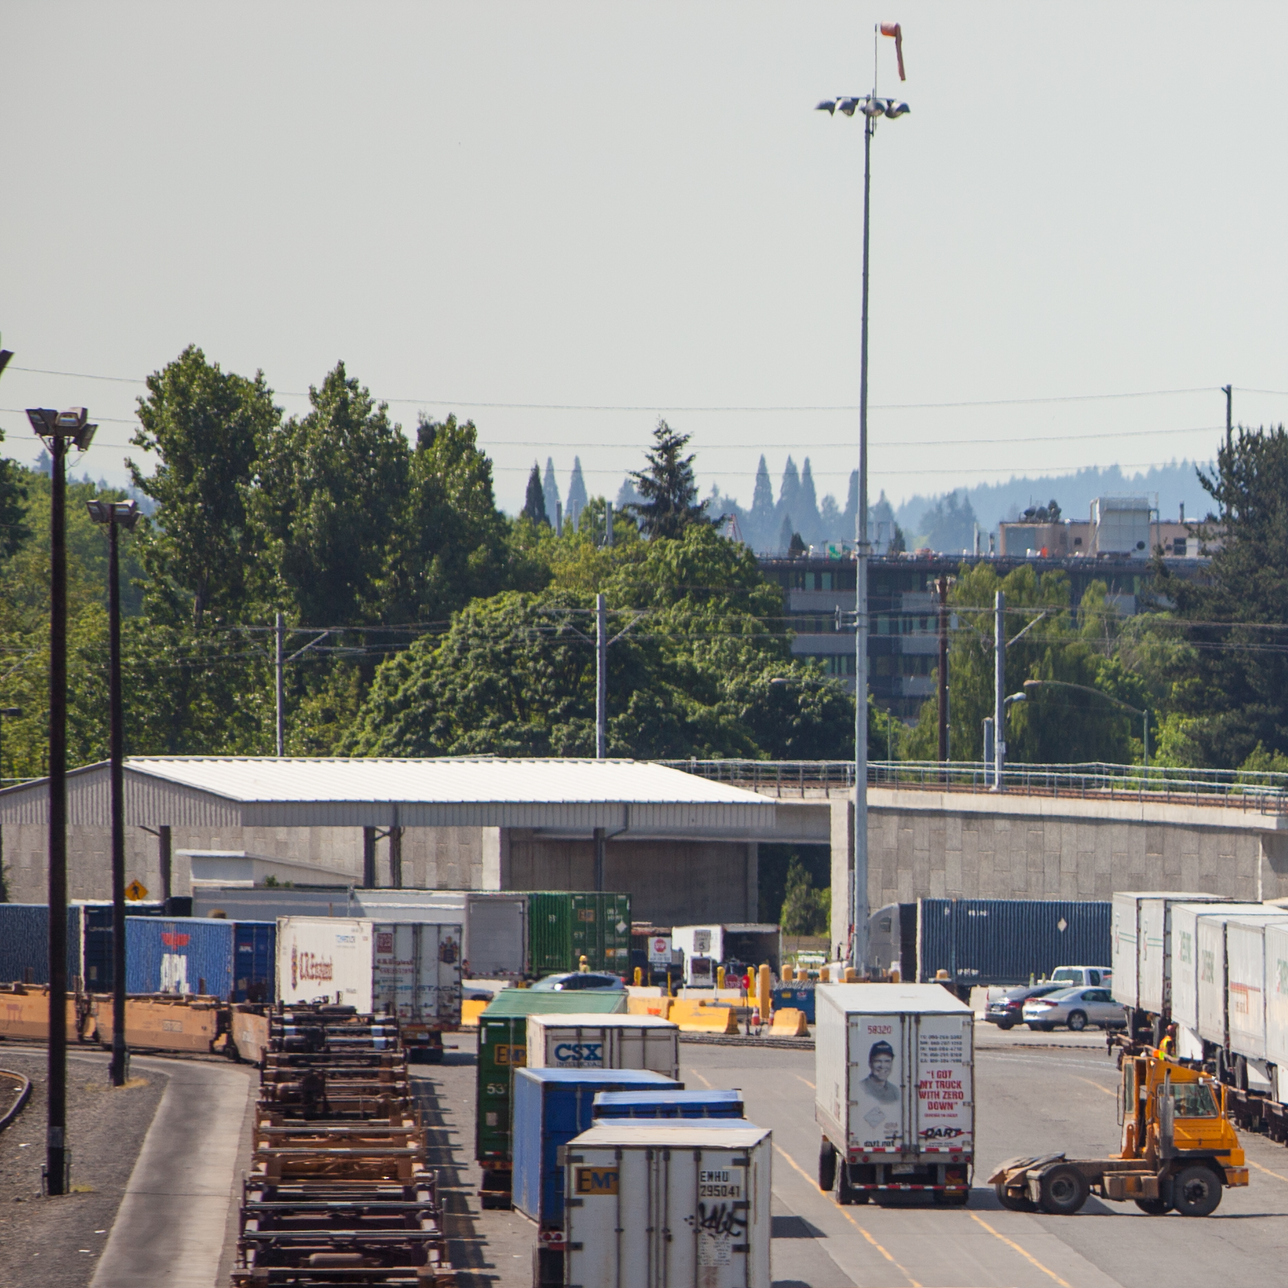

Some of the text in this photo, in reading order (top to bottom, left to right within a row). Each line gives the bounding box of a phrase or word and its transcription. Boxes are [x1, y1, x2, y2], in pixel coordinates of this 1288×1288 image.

[868, 1025, 892, 1035] 58320
[555, 1044, 603, 1061] CSX
[936, 1070, 952, 1079] GOT
[919, 1080, 962, 1089] MY TRUCK
[918, 1091, 964, 1100] WITH ZERO
[924, 1127, 962, 1139] DART
[700, 1170, 729, 1182] EMHU
[700, 1185, 740, 1198] 295041
